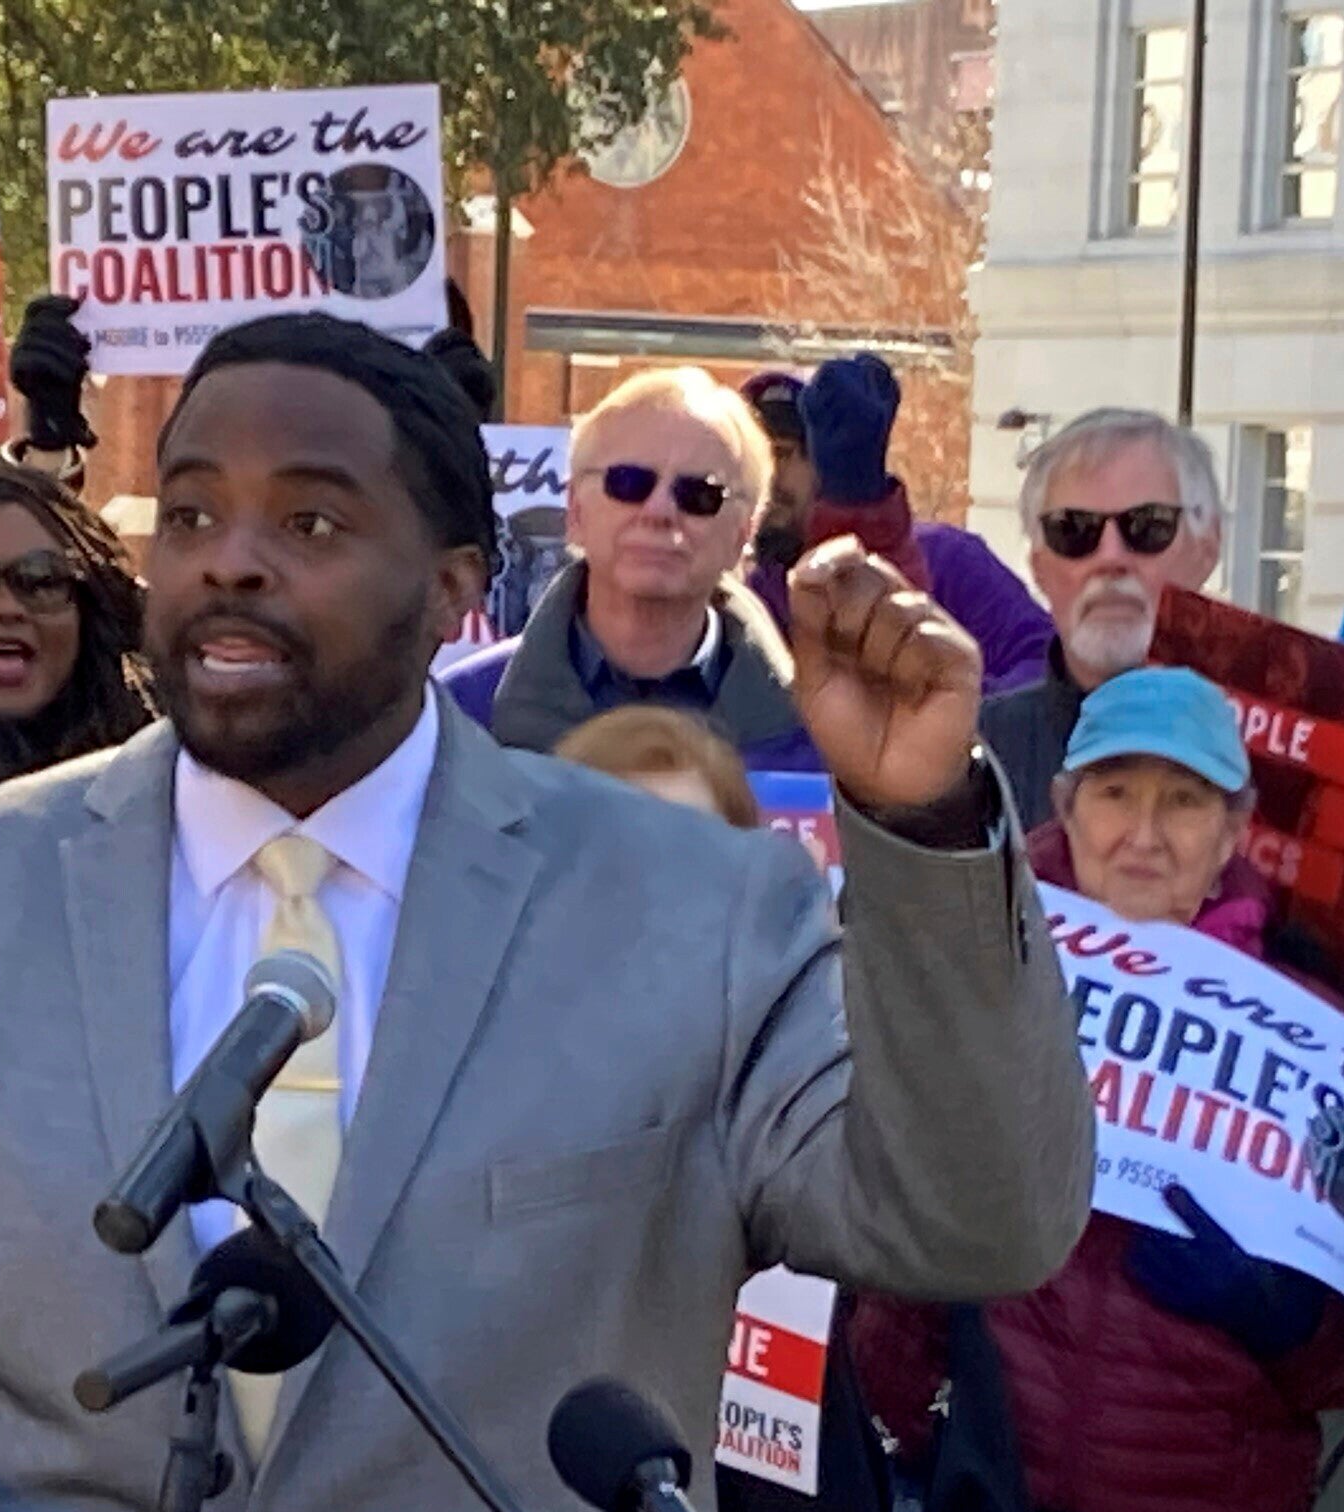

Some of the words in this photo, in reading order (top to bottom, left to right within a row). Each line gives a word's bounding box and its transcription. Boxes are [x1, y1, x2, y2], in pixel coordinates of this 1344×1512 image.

[58, 119, 162, 162] We
[174, 124, 297, 159] are
[311, 105, 428, 155] the
[58, 170, 335, 244] PEOPLE'S
[58, 242, 335, 306] COALITION
[489, 446, 568, 495] th
[1183, 977, 1327, 1052] are
[1088, 1058, 1338, 1204] ALITION
[722, 1427, 803, 1475] ALITION
[725, 1401, 803, 1452] OPLE'S
